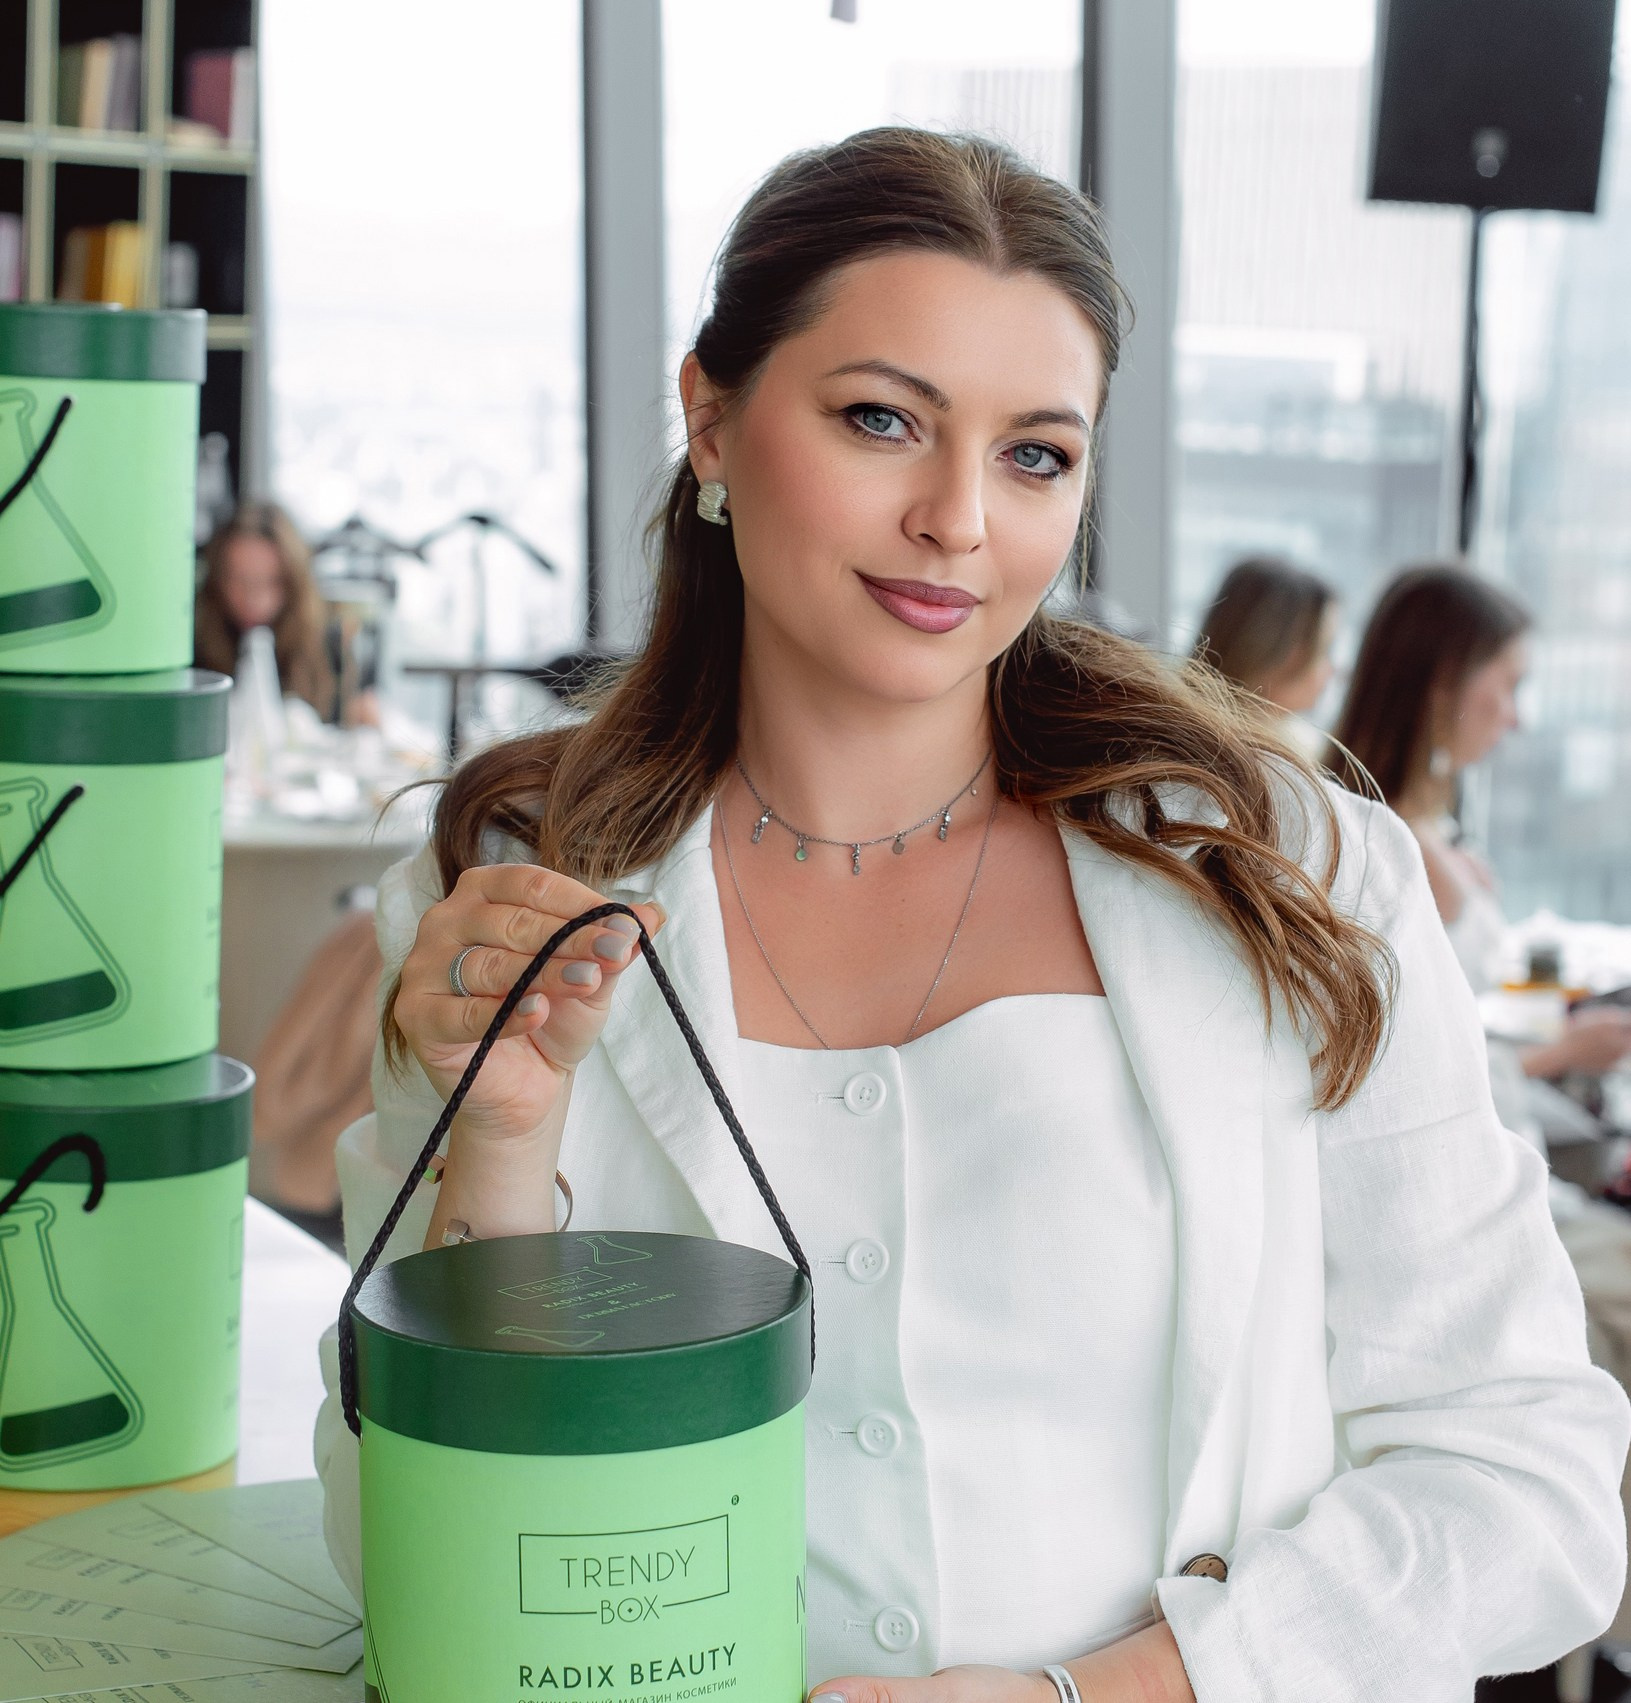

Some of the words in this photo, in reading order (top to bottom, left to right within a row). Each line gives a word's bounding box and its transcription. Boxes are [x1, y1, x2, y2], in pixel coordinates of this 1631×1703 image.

[522, 1275, 583, 1293] TRENDY
[541, 1295, 587, 1309] RADIX
[587, 1282, 639, 1298] BEAUTY
[559, 1545, 696, 1589] TRENDY
[600, 1594, 660, 1625] BOX
[519, 1665, 615, 1689] RADIX
[630, 1642, 736, 1686] BEAUTY
[676, 1677, 738, 1701] КОСМЕТИКИ
